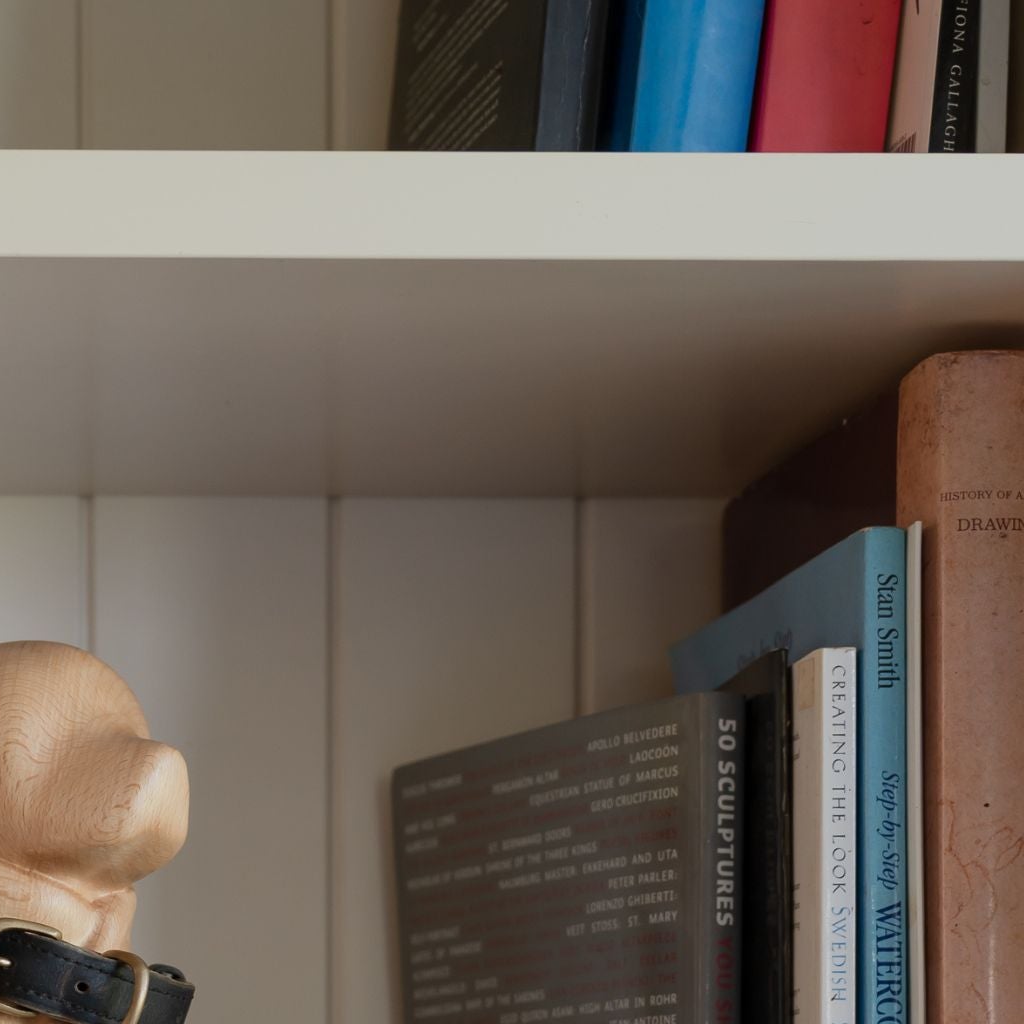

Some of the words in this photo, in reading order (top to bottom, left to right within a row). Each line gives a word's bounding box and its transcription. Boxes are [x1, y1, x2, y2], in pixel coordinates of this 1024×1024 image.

[939, 490, 993, 502] HISTORY
[996, 490, 1013, 500] OF
[877, 573, 898, 619] Stan
[878, 628, 901, 690] Smith
[717, 718, 737, 752] 50
[831, 664, 847, 773] CREATING
[587, 735, 620, 752] APOLLO
[623, 723, 678, 745] BELVEDERE
[584, 776, 614, 794] STATUE
[619, 774, 632, 787] OF
[635, 765, 679, 783] MARCUS
[616, 785, 679, 807] CRUCIFIXION
[831, 784, 847, 823] THE
[715, 762, 736, 927] SCULPTURES
[877, 770, 902, 890] Step-by-Step
[631, 851, 652, 865] AND
[657, 848, 678, 862] UTA
[831, 834, 848, 894] LOOK
[608, 875, 634, 890] PETER
[637, 868, 678, 884] PARLER:
[648, 910, 678, 924] MARY
[714, 936, 734, 990] YOU
[831, 907, 848, 1002] SWEDISH
[604, 998, 630, 1012] ALTAR
[634, 996, 646, 1008] IN
[649, 993, 677, 1006] ROHR
